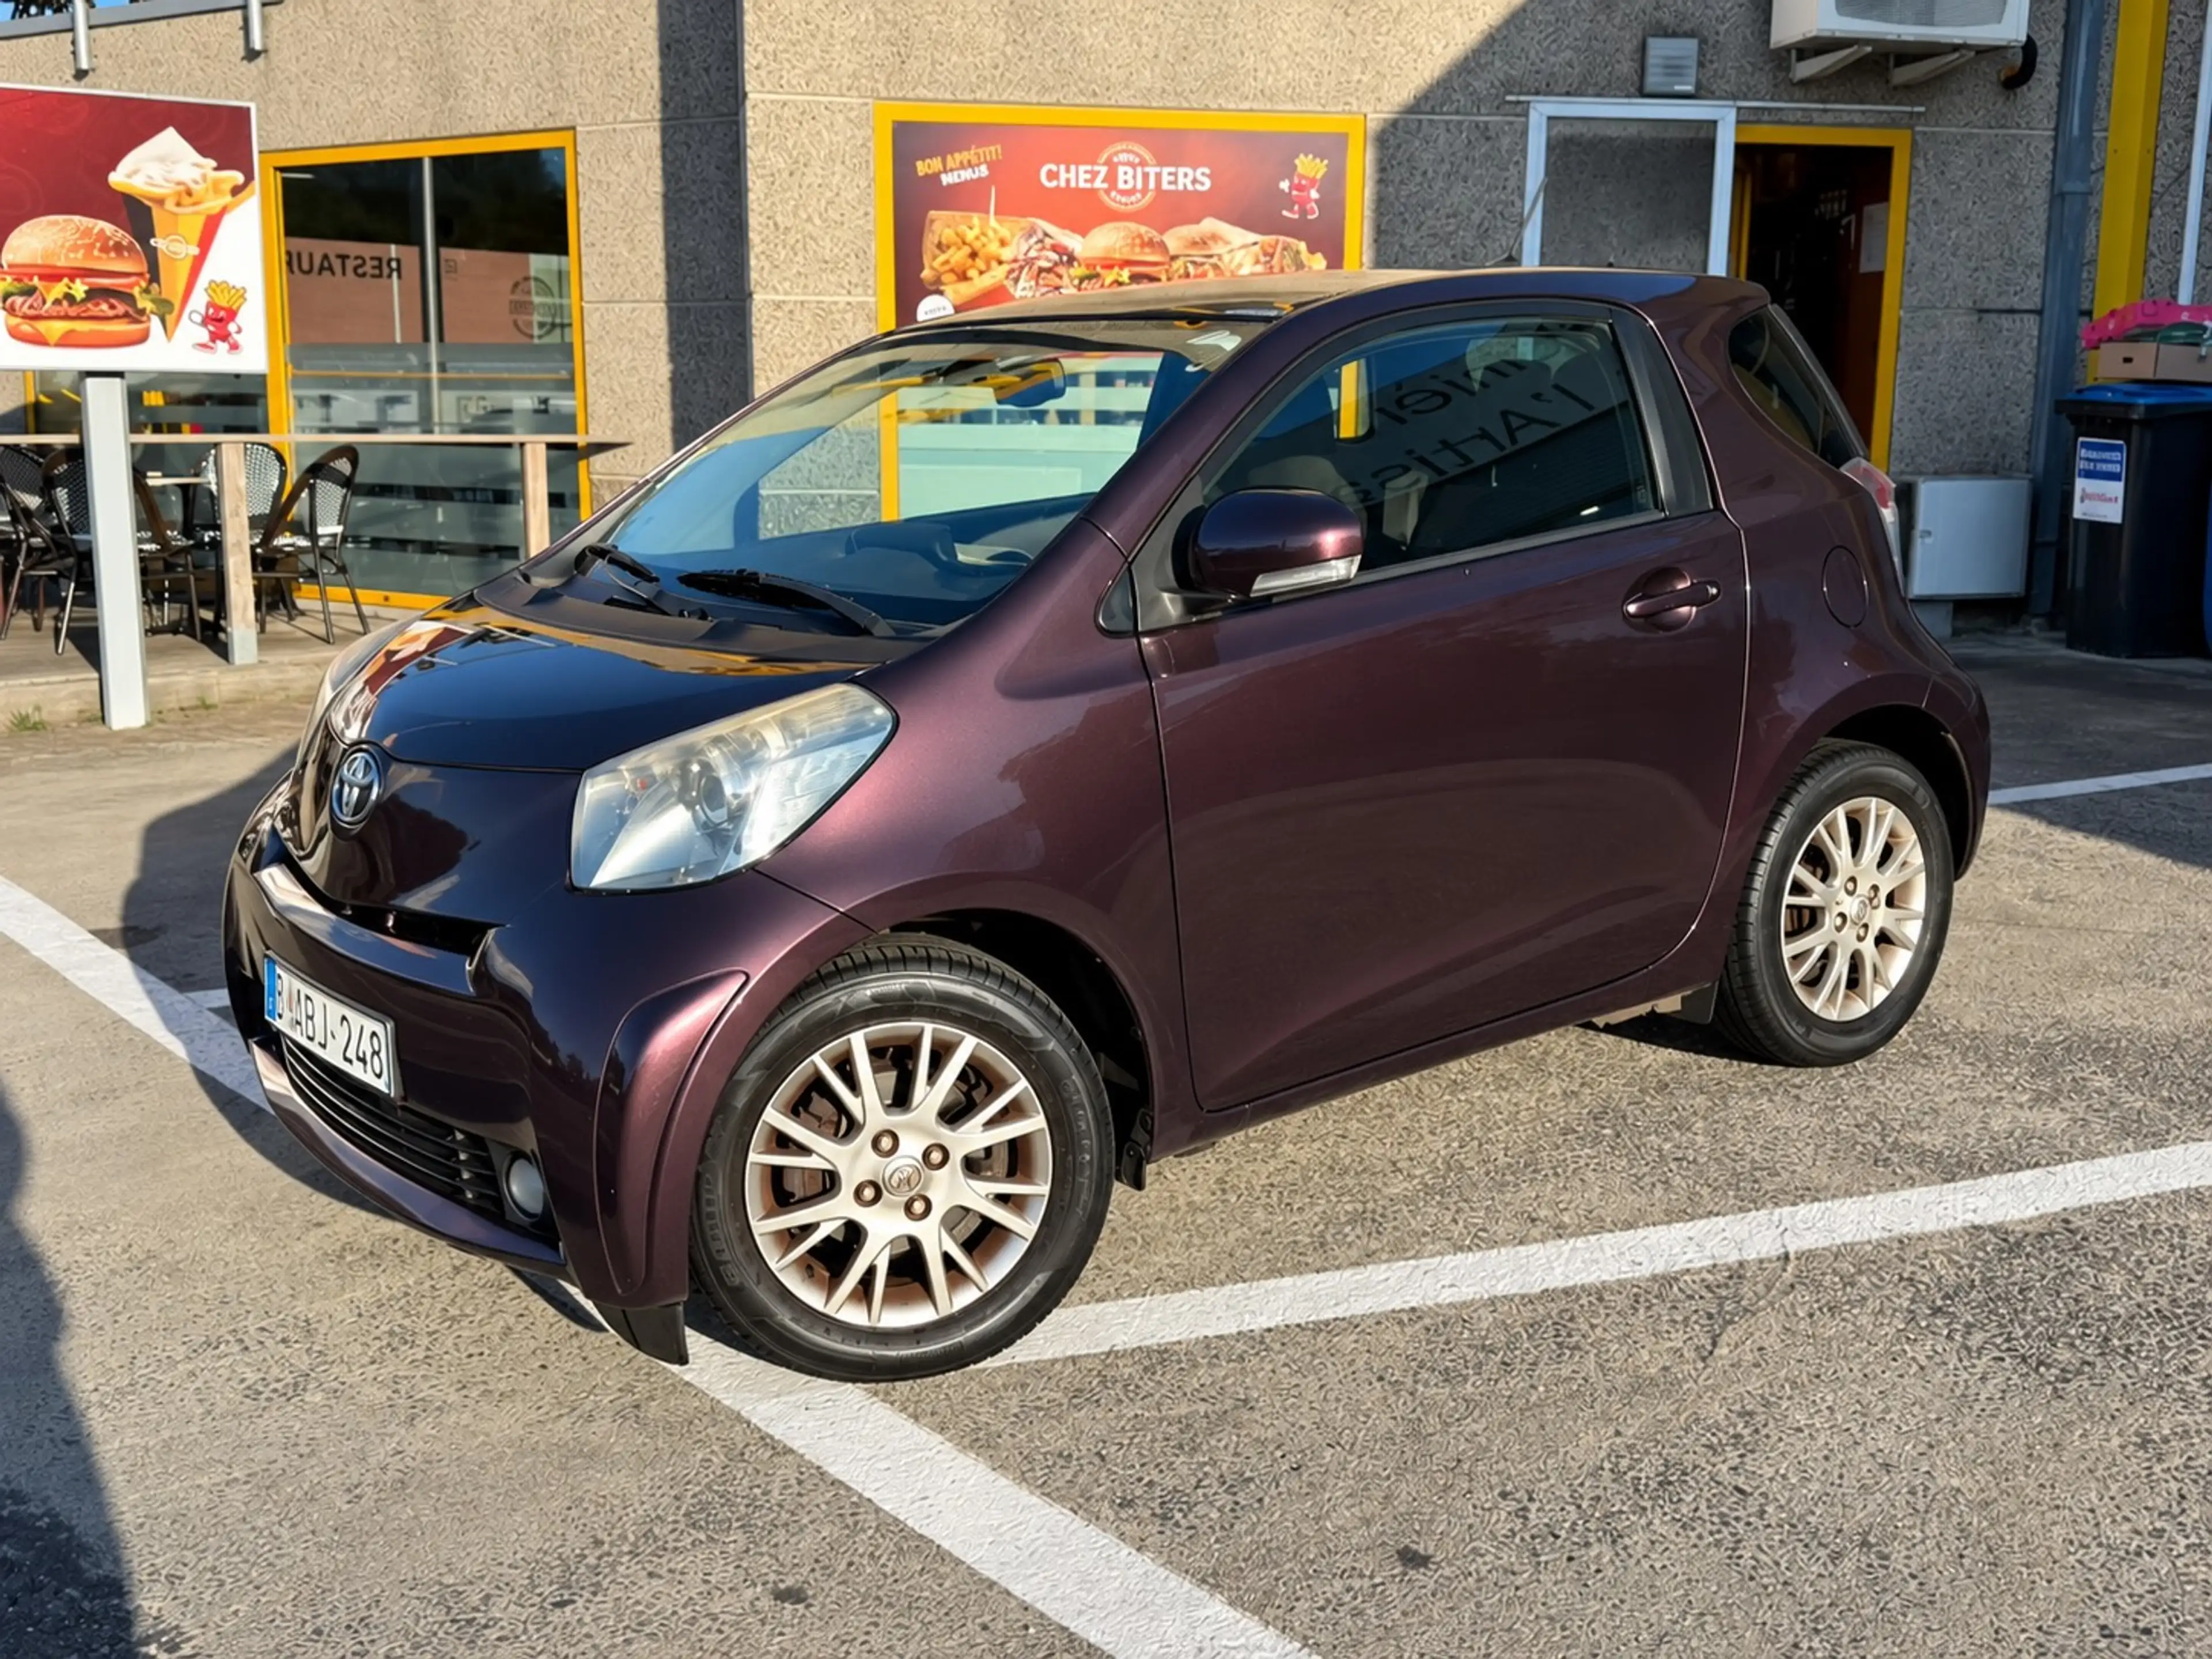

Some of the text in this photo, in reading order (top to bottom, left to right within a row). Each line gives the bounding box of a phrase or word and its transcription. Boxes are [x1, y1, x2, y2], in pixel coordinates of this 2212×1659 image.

[916, 156, 943, 176] BON
[1040, 164, 1211, 191] CHEZ BITERS
